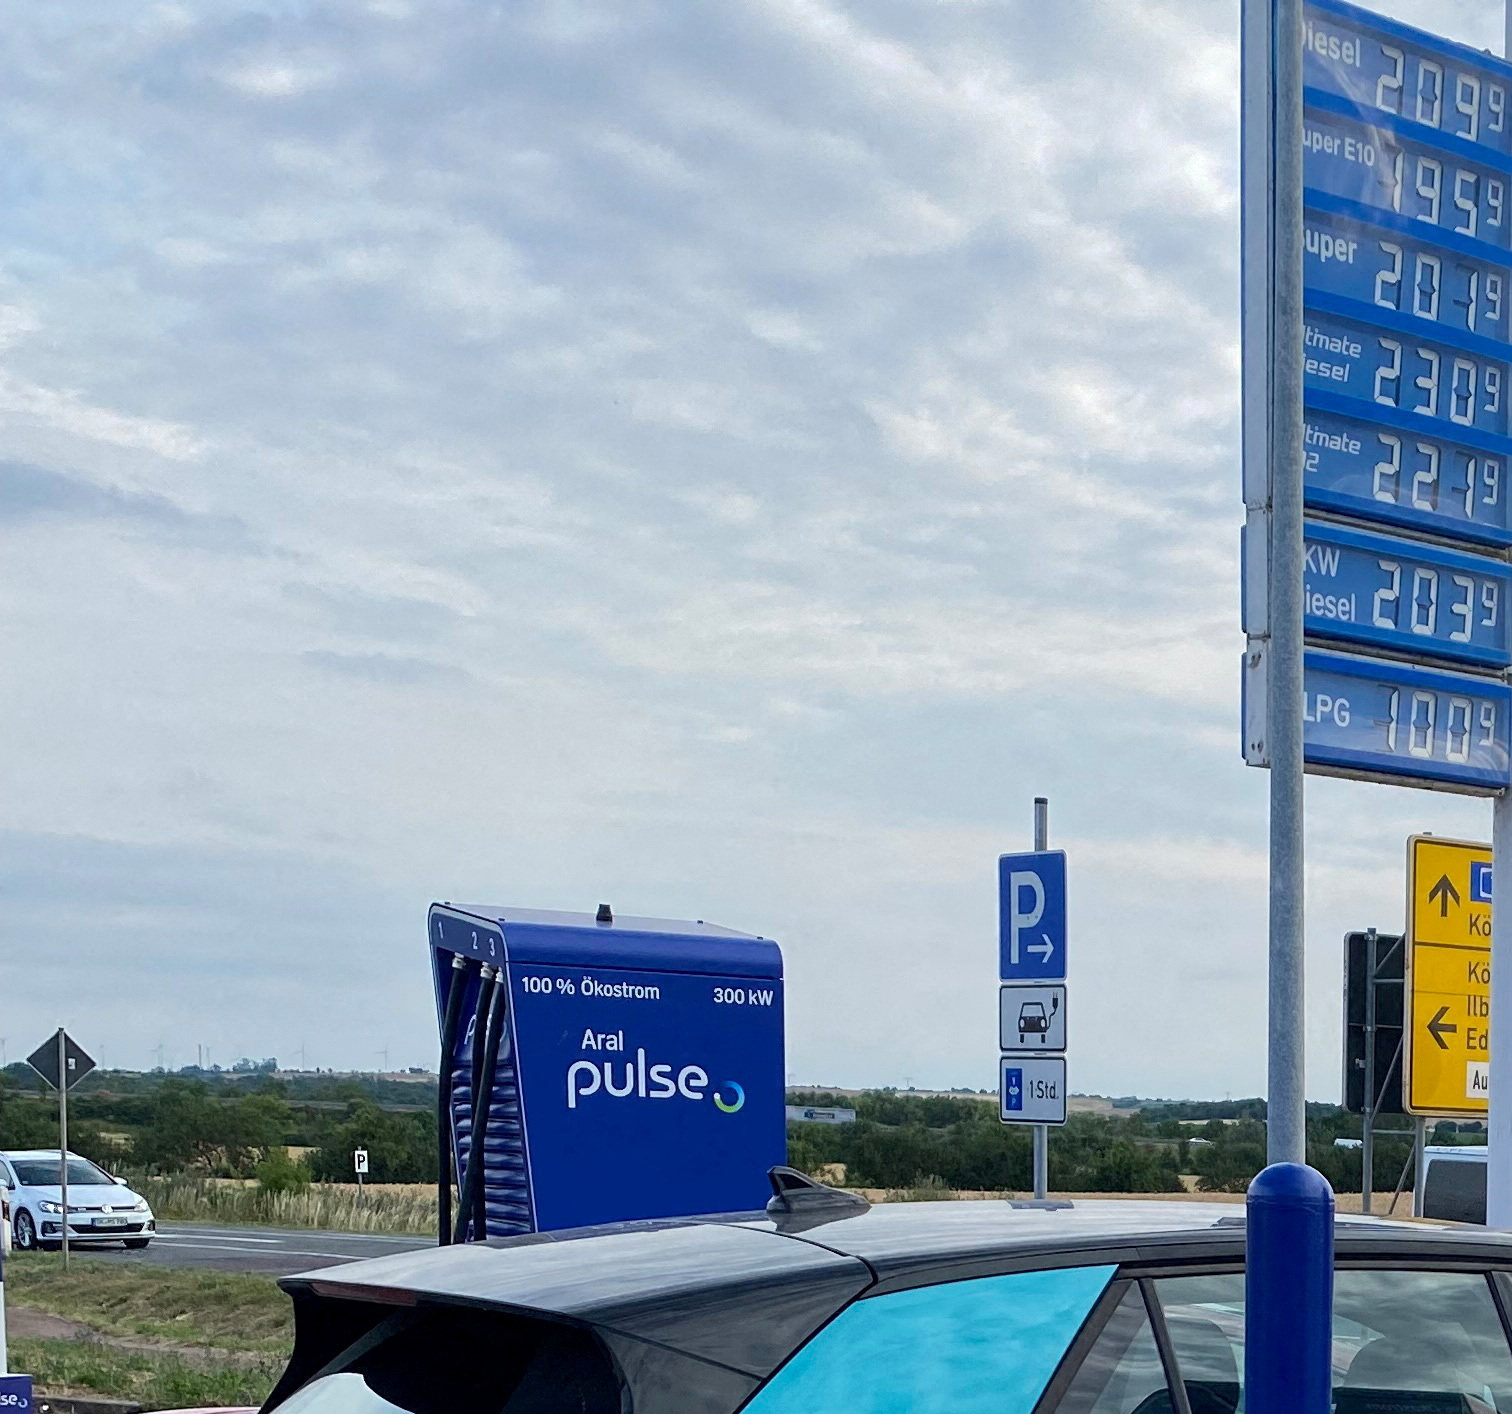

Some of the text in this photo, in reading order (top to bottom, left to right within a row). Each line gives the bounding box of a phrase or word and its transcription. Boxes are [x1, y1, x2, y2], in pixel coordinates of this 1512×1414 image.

[1303, 128, 1341, 156] uper
[1344, 137, 1375, 166] E10
[1301, 228, 1358, 264] uper
[1303, 545, 1340, 577] KW
[1305, 584, 1356, 622] iesel
[1304, 691, 1351, 727] LPG
[438, 922, 444, 939] 1
[1010, 870, 1046, 965] P
[471, 931, 478, 951] 2
[488, 937, 496, 957] 3
[521, 975, 661, 1000] 100 % Ökostrom
[713, 987, 774, 1006] 300 kW
[581, 1028, 624, 1052] Aral
[567, 1048, 709, 1109] pulse
[357, 1153, 366, 1169] P
